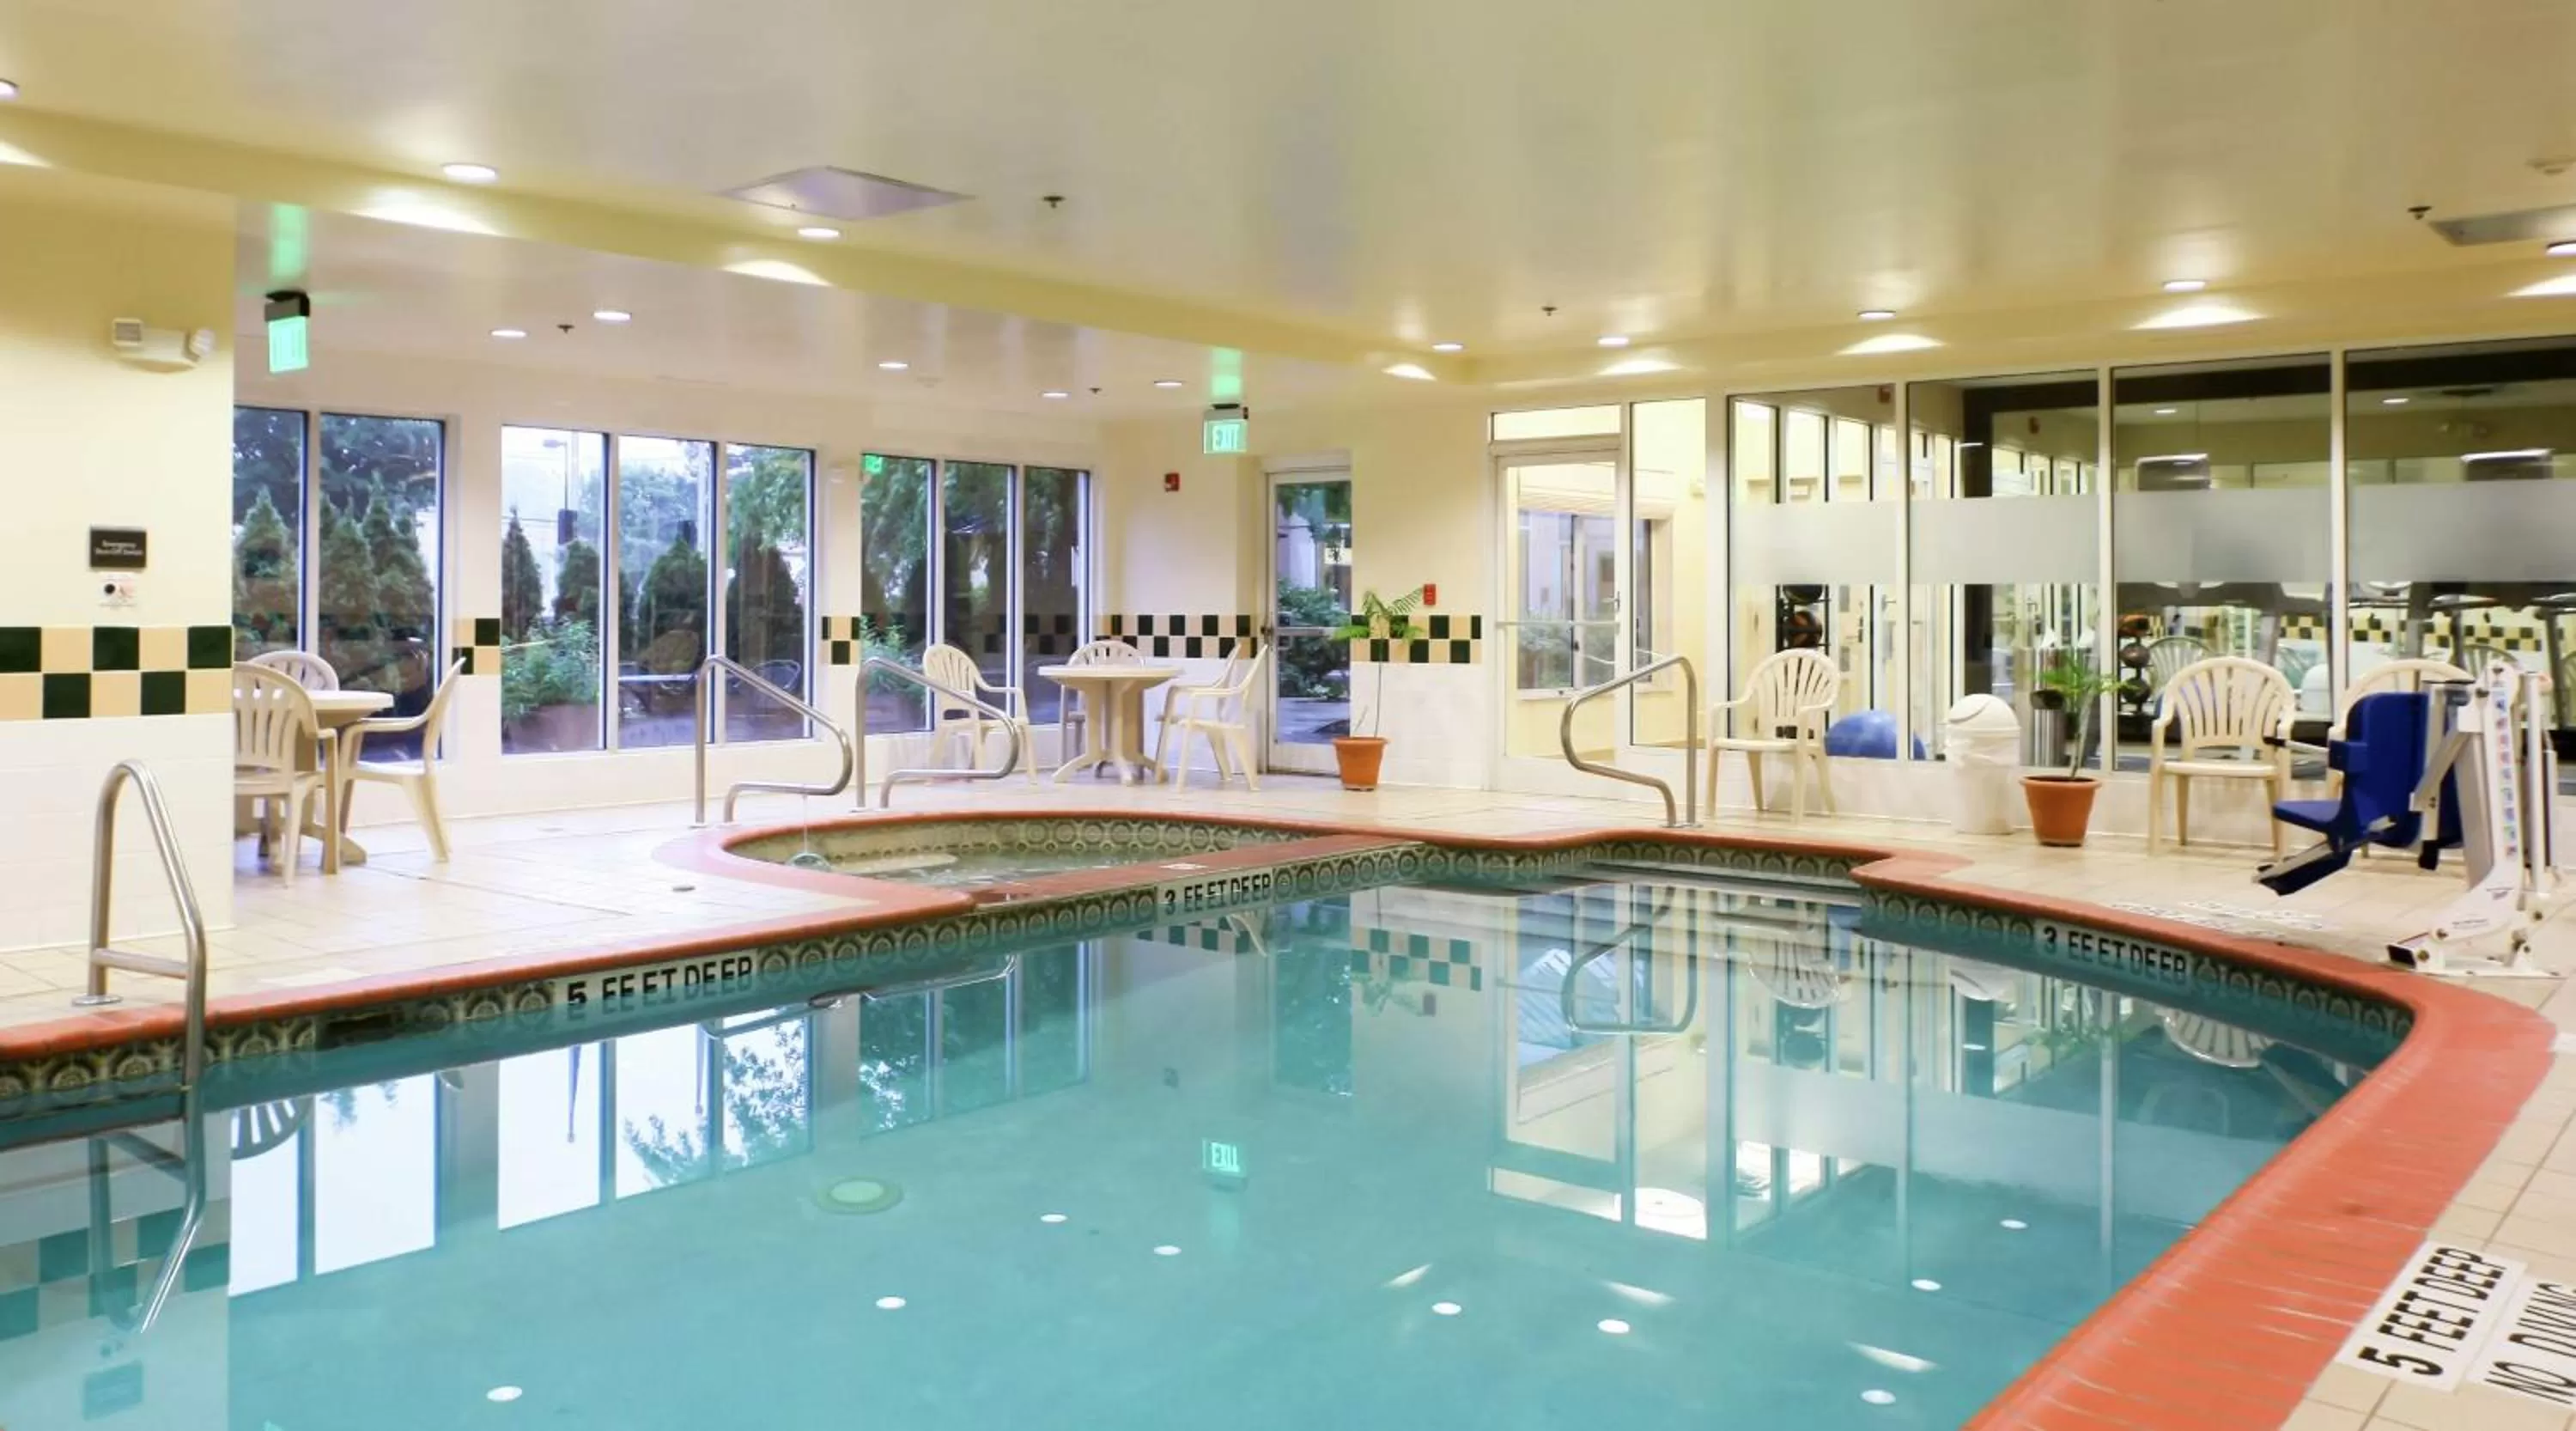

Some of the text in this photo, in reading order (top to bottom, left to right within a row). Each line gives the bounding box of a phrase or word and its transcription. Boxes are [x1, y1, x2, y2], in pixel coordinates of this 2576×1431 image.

[1212, 424, 1240, 450] EXIT
[1165, 873, 1272, 915] 3 FEET DEEP
[2043, 925, 2187, 985] 3 FEET DEEP
[567, 956, 753, 1020] 5 FEET DEEP
[2356, 1247, 2508, 1376] 5 FEET DEEP
[2483, 1361, 2576, 1405] NO
